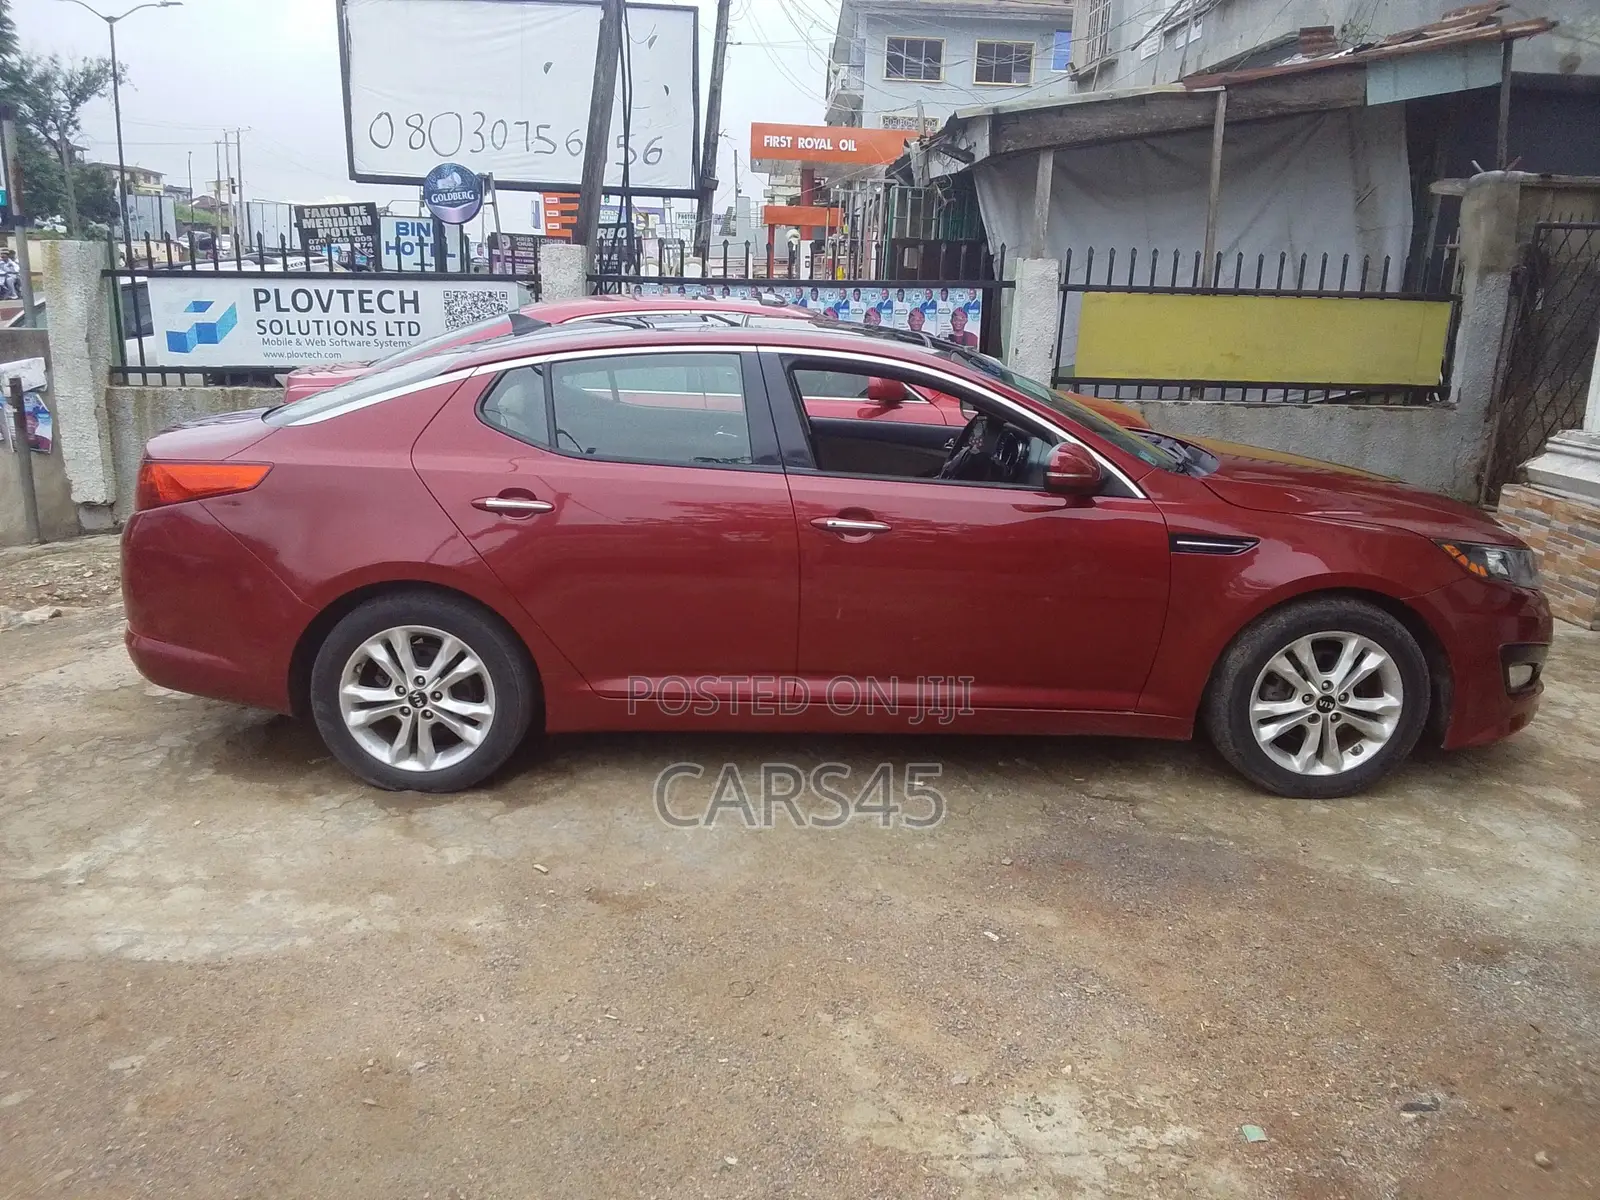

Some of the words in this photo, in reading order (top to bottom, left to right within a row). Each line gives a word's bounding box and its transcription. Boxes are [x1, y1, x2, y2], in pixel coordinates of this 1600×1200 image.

[764, 135, 792, 148] FIRST
[798, 137, 833, 151] ROYAL
[839, 139, 857, 151] OIL
[431, 190, 475, 203] GOLDBERG
[304, 207, 347, 218] FAKOL
[348, 205, 368, 216] DE
[302, 215, 372, 229] MERIDIAN
[317, 226, 364, 238] MOTEL
[253, 288, 420, 314] PLOVTECH
[256, 319, 377, 337] SOLUTIONS
[385, 320, 421, 337] LTD
[262, 337, 293, 347] Mobile
[296, 338, 303, 346] &
[304, 338, 327, 347] Web
[329, 338, 371, 348] Software
[373, 339, 412, 350] Systems
[263, 350, 342, 360] www.plovtech.com
